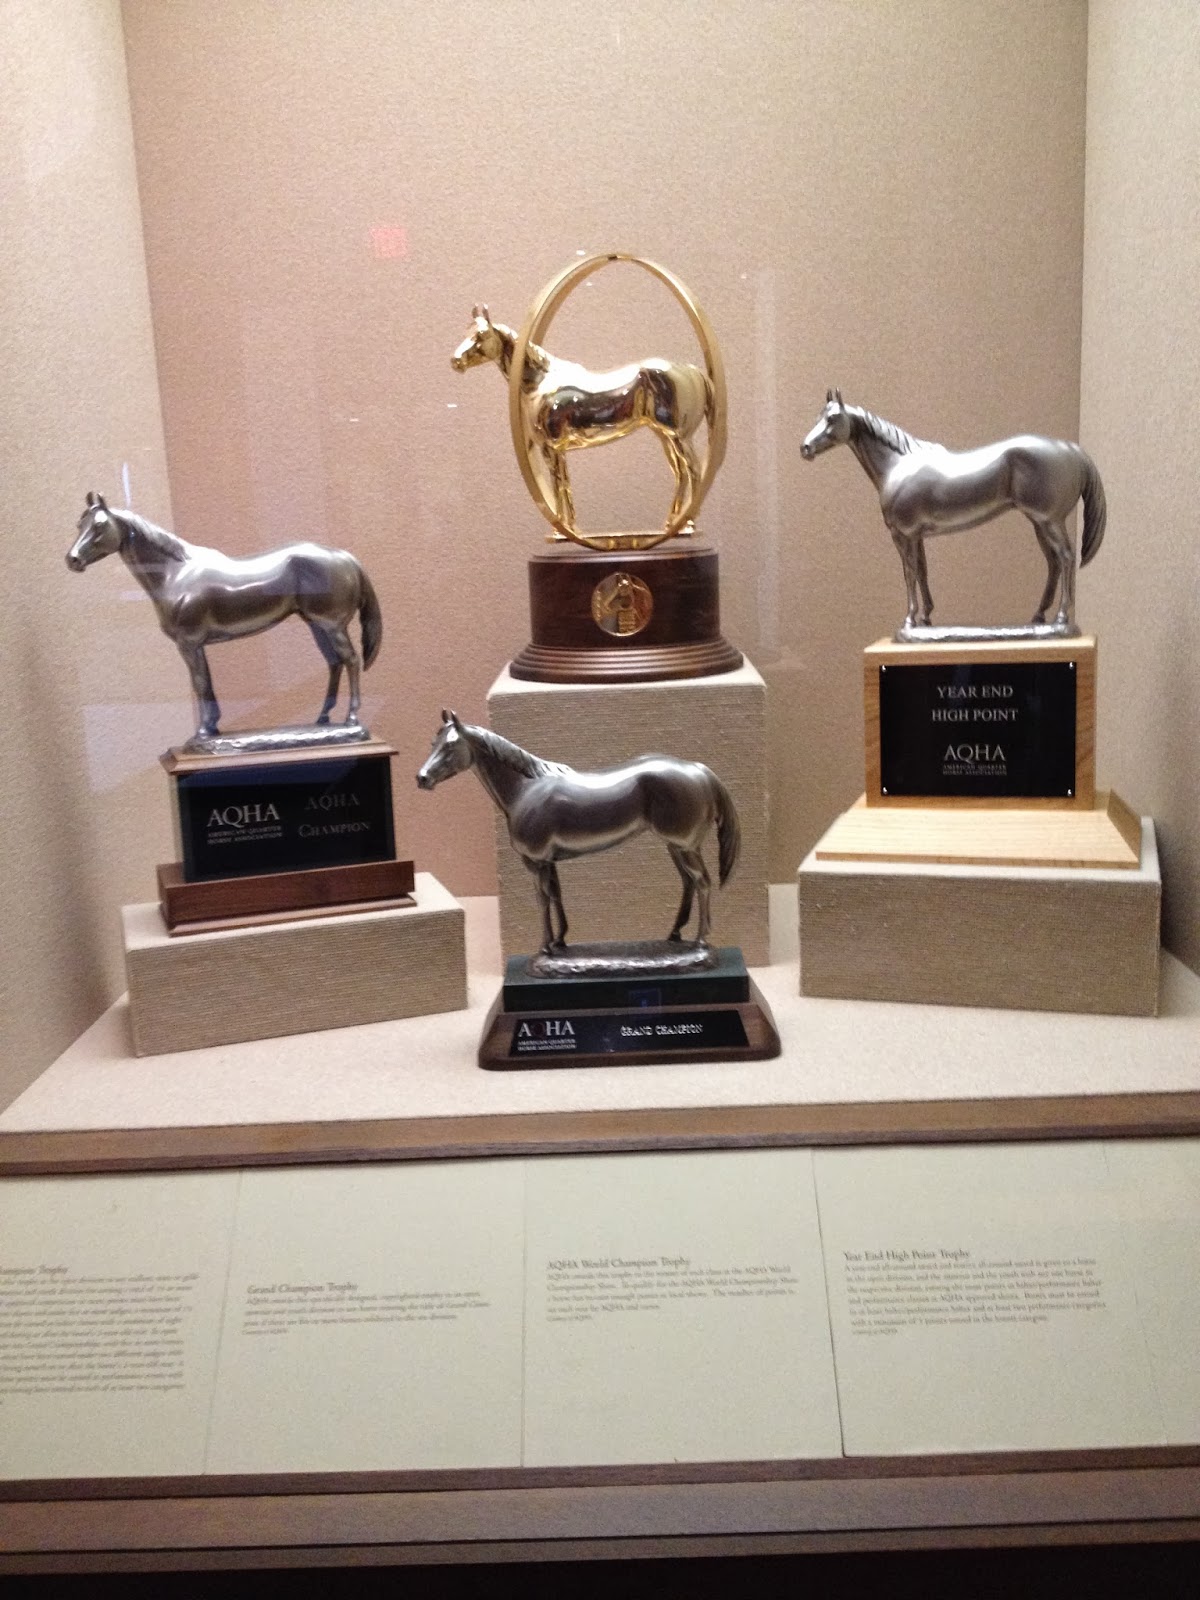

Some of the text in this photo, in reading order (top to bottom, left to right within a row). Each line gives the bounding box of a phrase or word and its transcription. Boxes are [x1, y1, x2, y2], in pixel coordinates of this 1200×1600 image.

[937, 685, 1013, 699] YEAR END
[932, 708, 1018, 722] HIGH POINT
[943, 743, 1006, 764] AQHA
[304, 793, 360, 811] AQHA
[207, 803, 281, 829] AQHA
[620, 1023, 703, 1037] GRAND CHAMPION
[843, 1248, 970, 1262] Year End High Point Trophy
[548, 1256, 690, 1270] AQHA World Champion Trophy
[278, 1283, 325, 1296] Champion
[327, 1282, 358, 1294] Trophy
